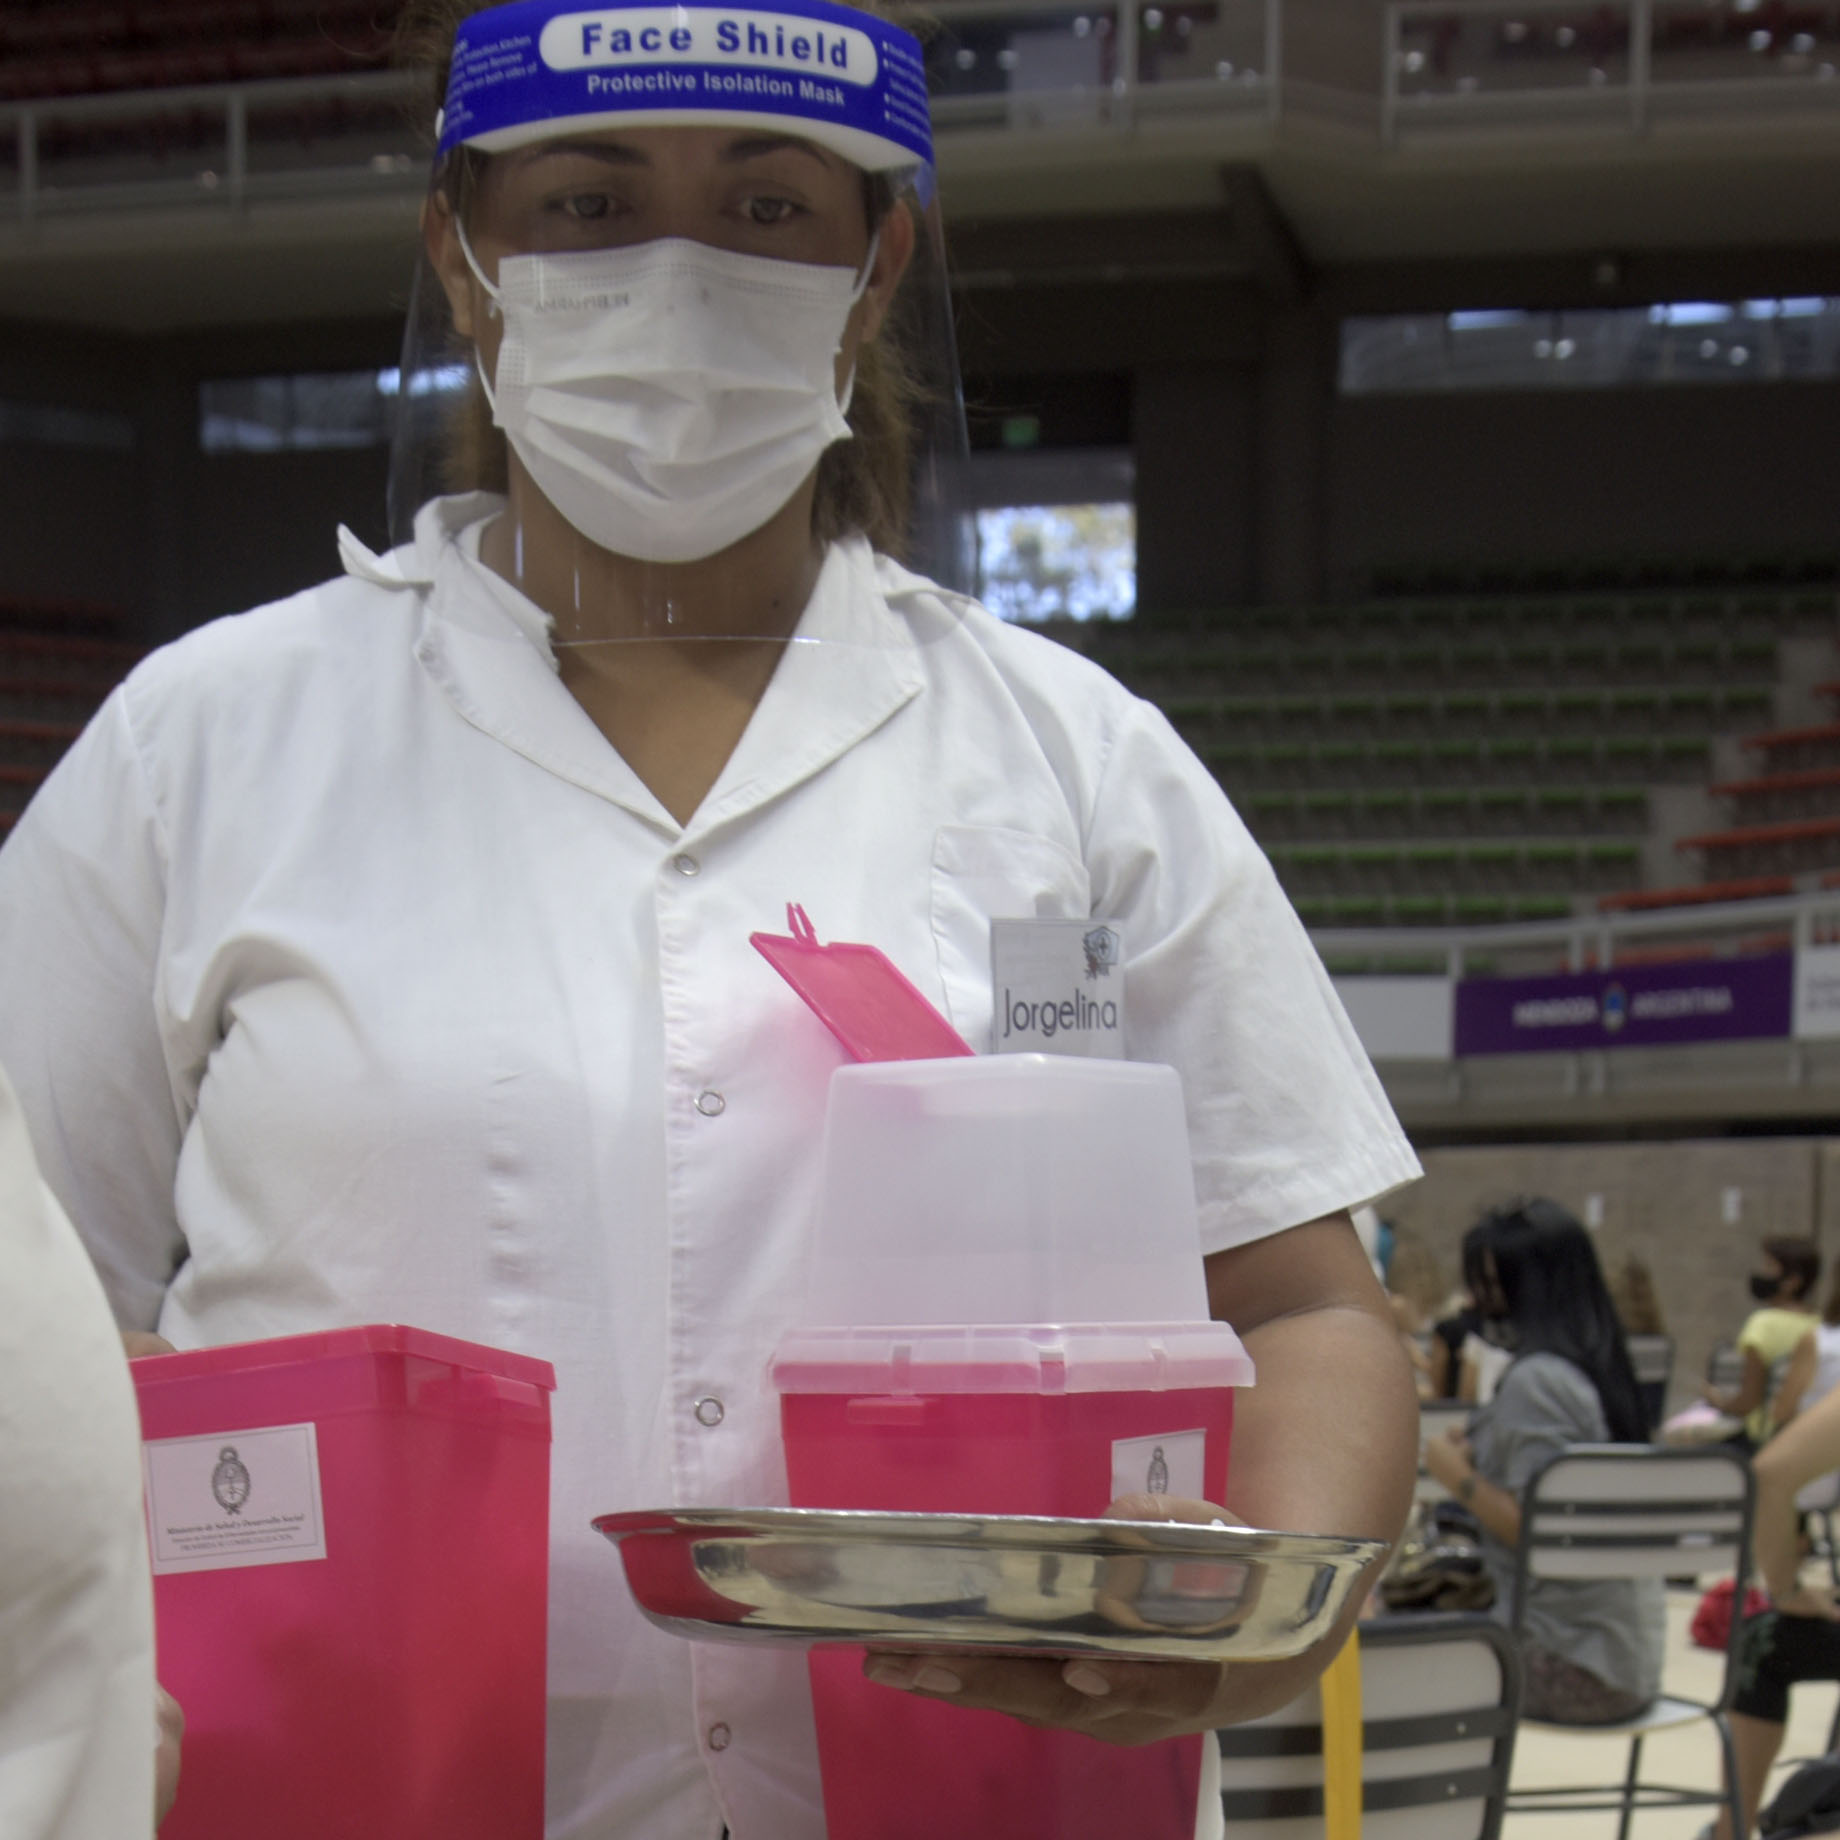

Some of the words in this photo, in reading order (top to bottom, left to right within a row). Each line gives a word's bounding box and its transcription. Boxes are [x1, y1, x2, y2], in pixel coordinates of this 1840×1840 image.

[582, 23, 692, 55] Face
[716, 20, 847, 69] Shield
[587, 70, 697, 95] Protective
[704, 71, 793, 96] Isolation
[799, 80, 845, 105] Mask
[1003, 987, 1117, 1038] Jorgelina
